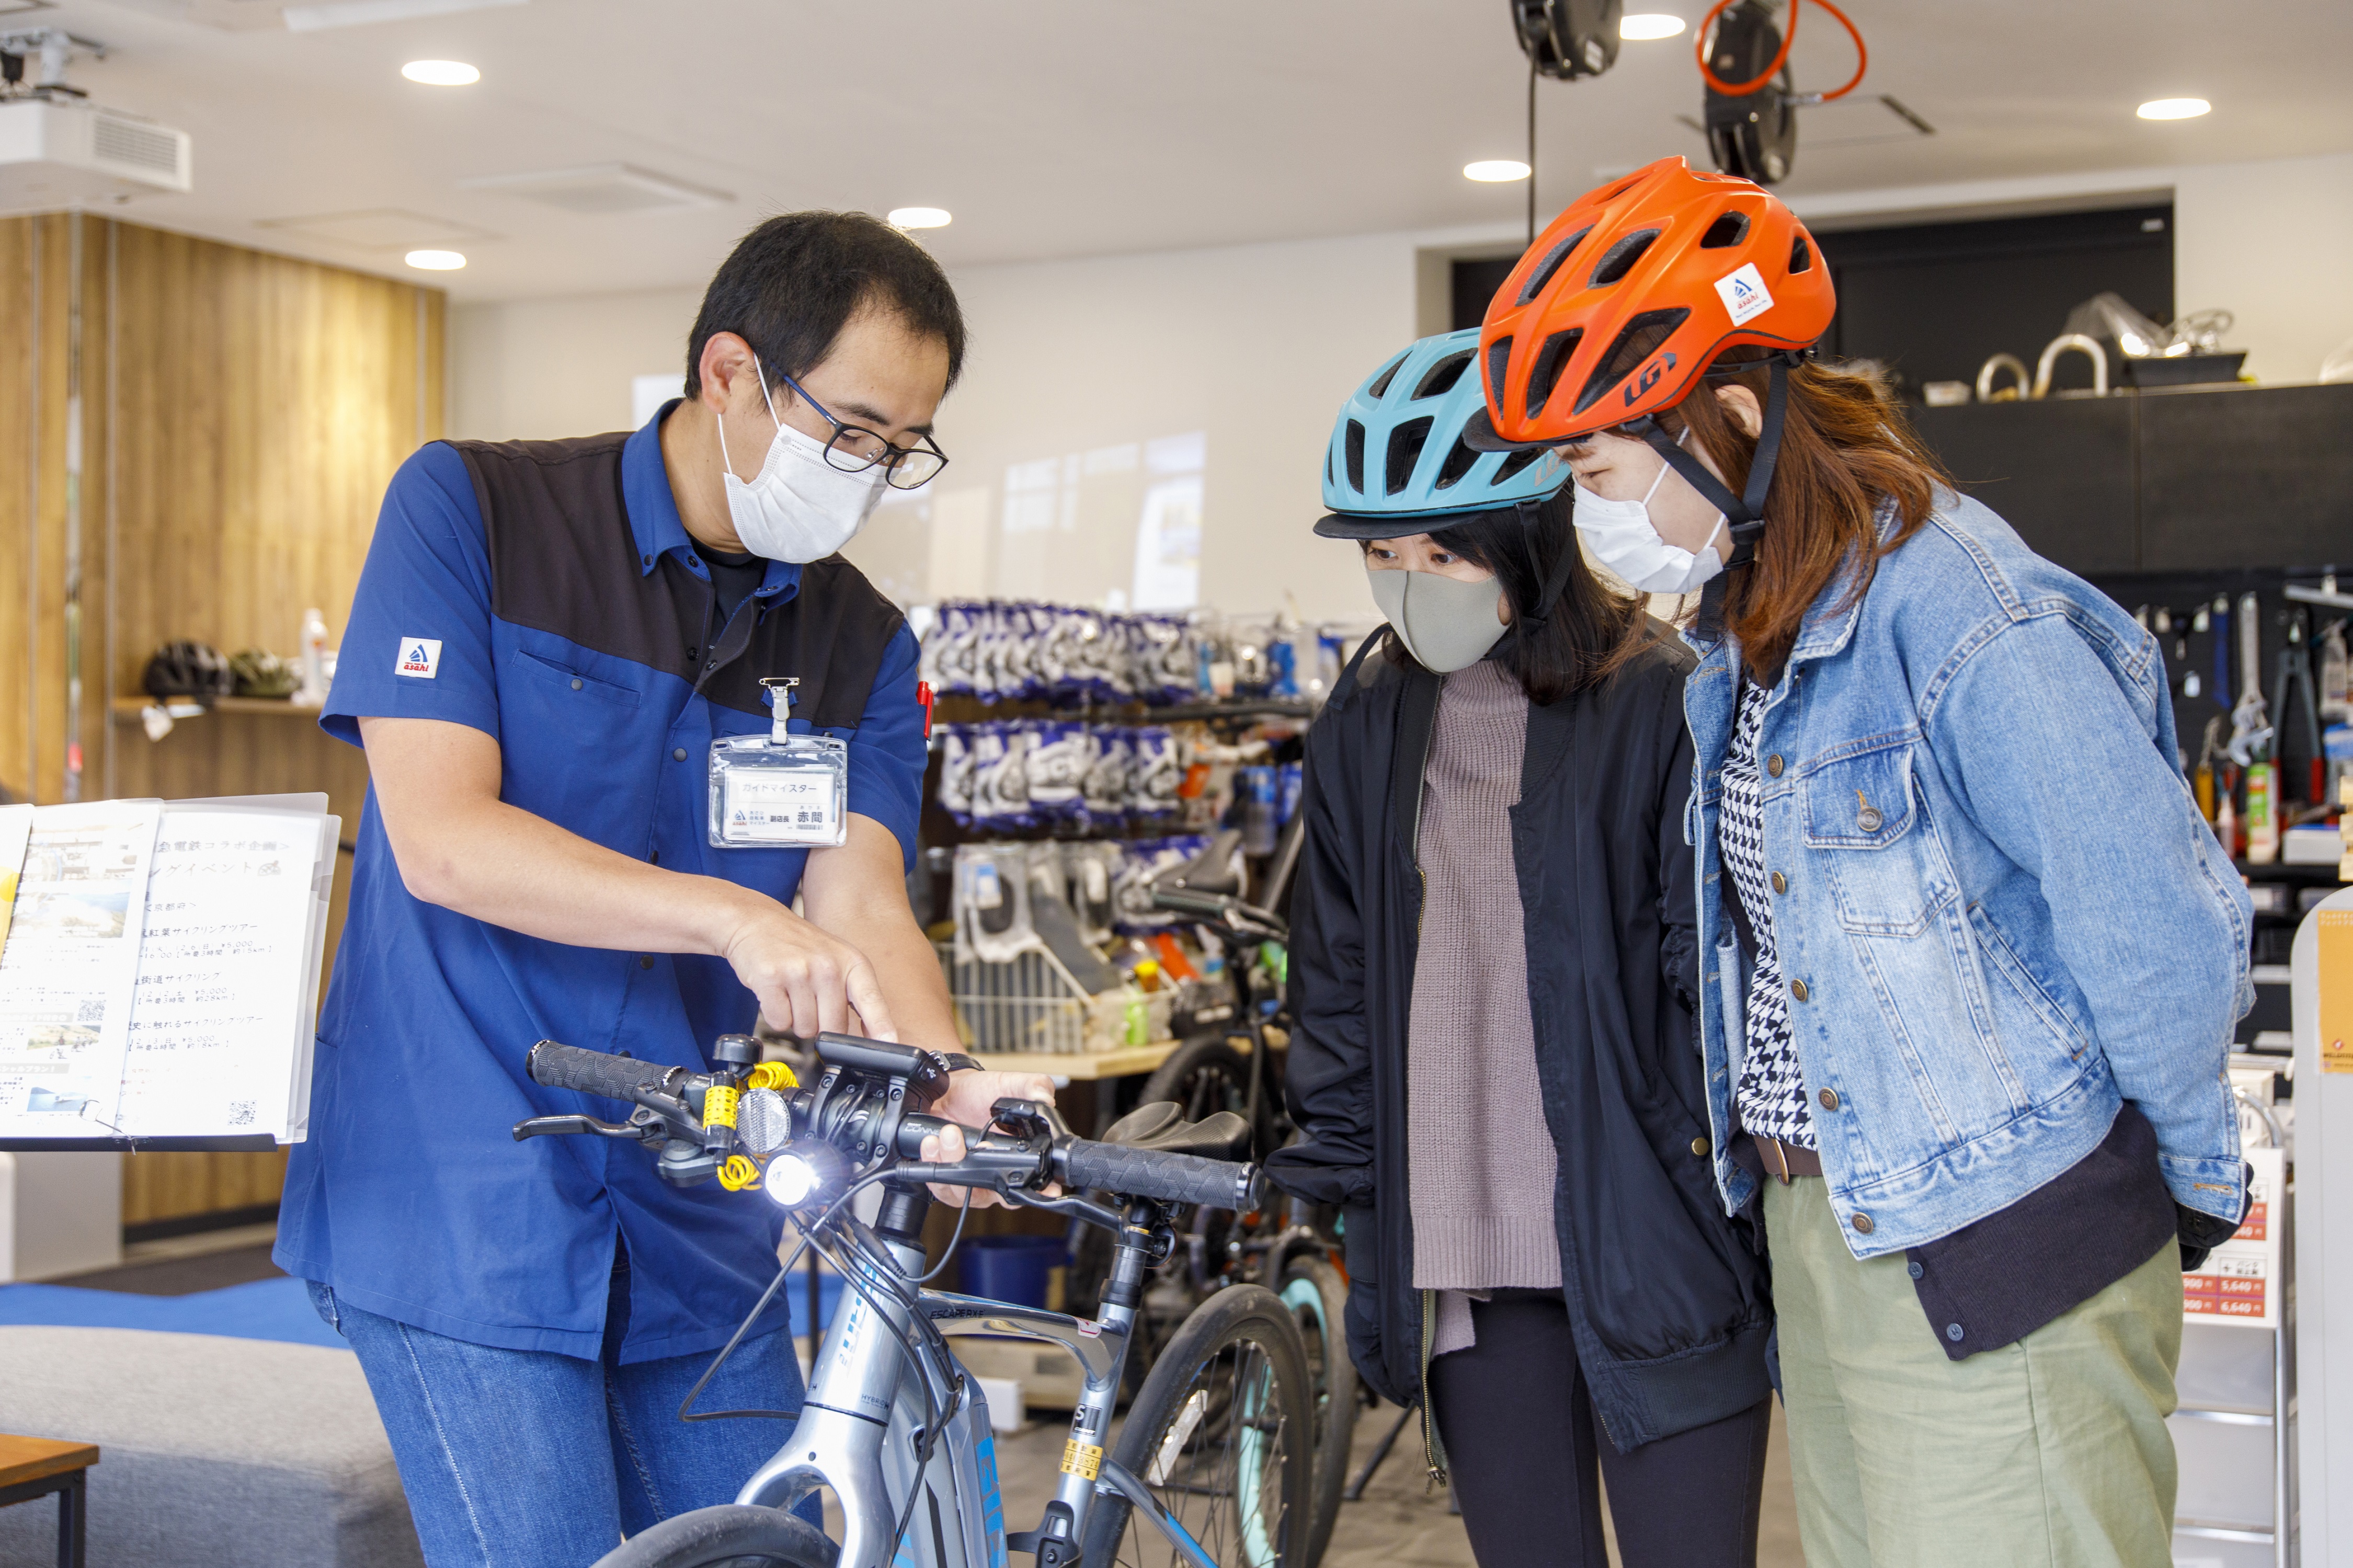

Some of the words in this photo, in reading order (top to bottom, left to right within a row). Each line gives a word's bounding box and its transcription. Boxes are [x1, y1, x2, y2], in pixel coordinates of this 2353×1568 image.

[403, 663, 429, 672] asahi
[743, 783, 817, 793] ガイドマイスター
[797, 811, 823, 823] 赤間
[1075, 1404, 1086, 1421] S
